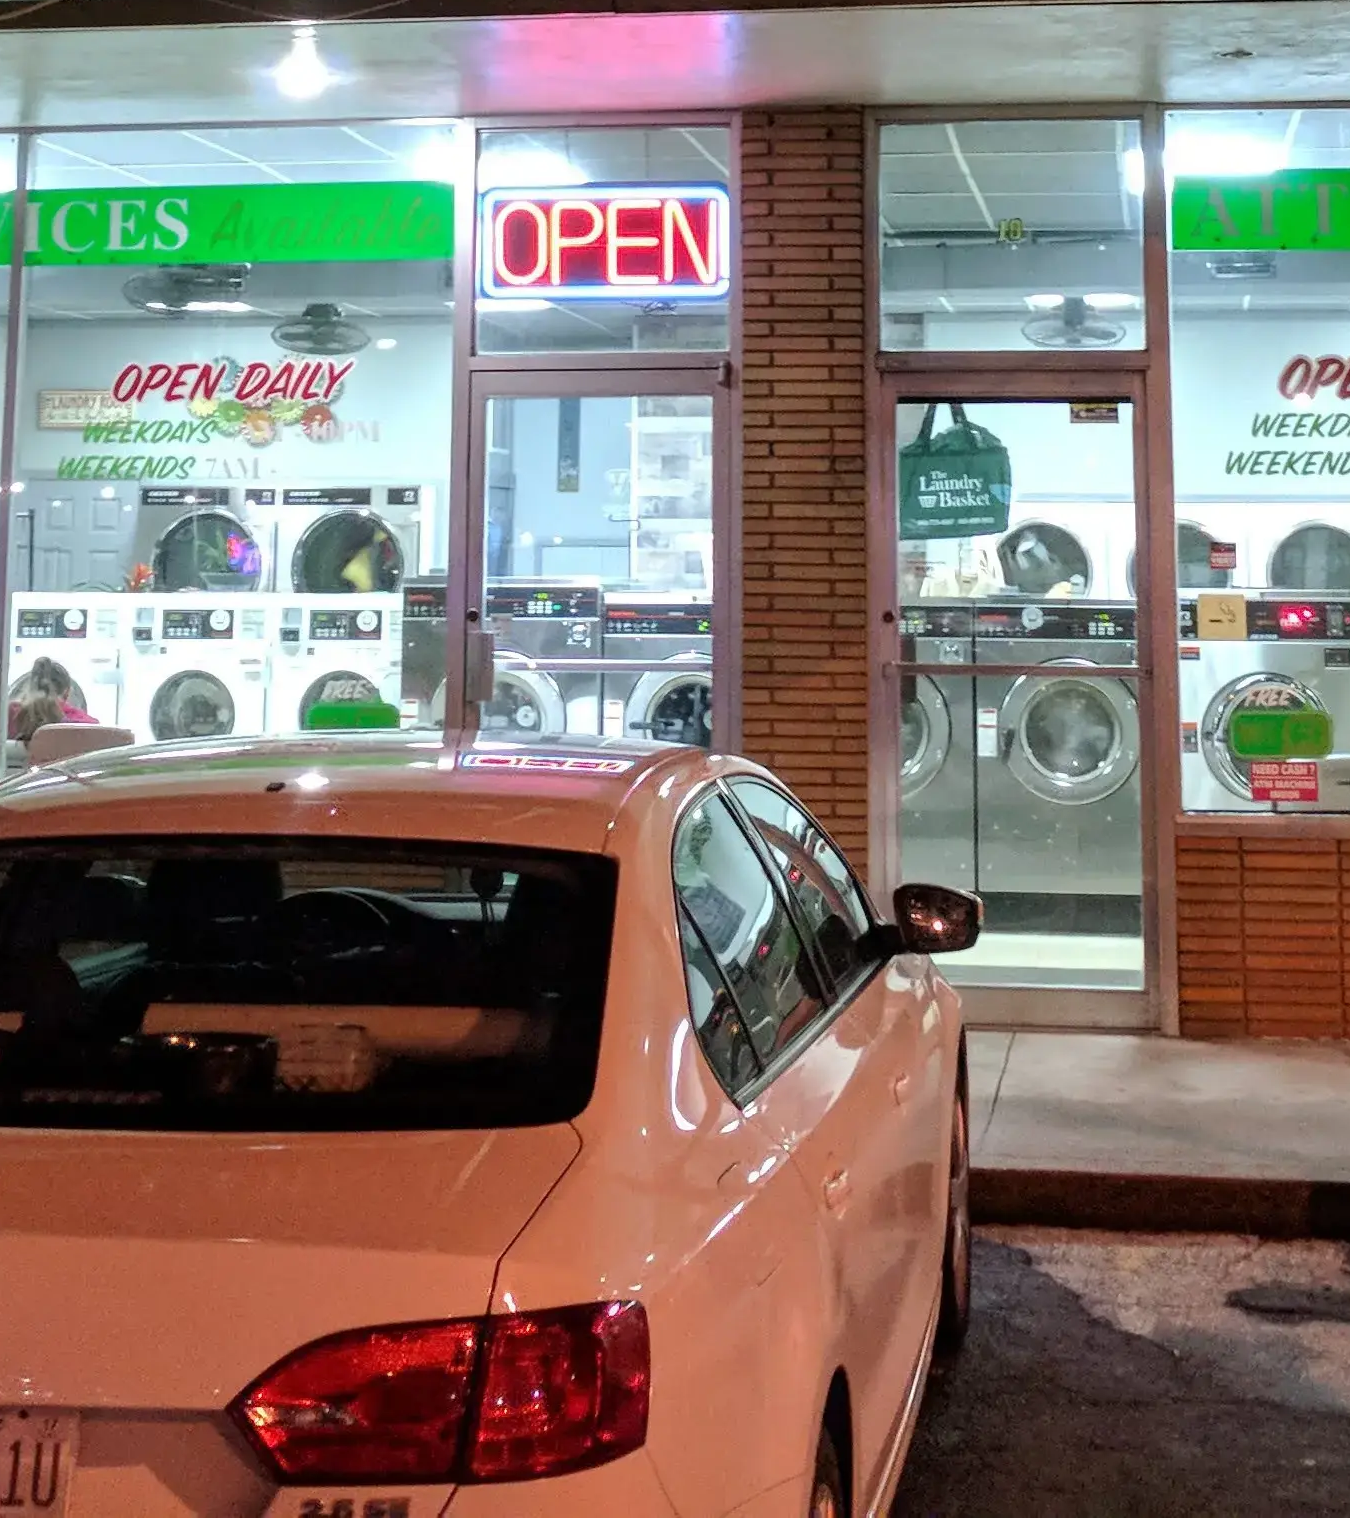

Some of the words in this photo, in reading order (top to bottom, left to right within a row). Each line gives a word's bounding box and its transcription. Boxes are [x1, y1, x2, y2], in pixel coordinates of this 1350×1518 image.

[493, 198, 719, 287] OPEN
[112, 362, 227, 404] OPEN
[235, 361, 354, 402] DAILY
[82, 419, 220, 445] WEEKDAYS
[56, 455, 197, 481] WEEKENDS
[205, 457, 261, 480] 7AM
[930, 470, 948, 480] The
[919, 473, 984, 492] Laundry
[938, 490, 991, 508] Basket
[1243, 687, 1291, 707] FREE
[1252, 763, 1280, 775] NEED
